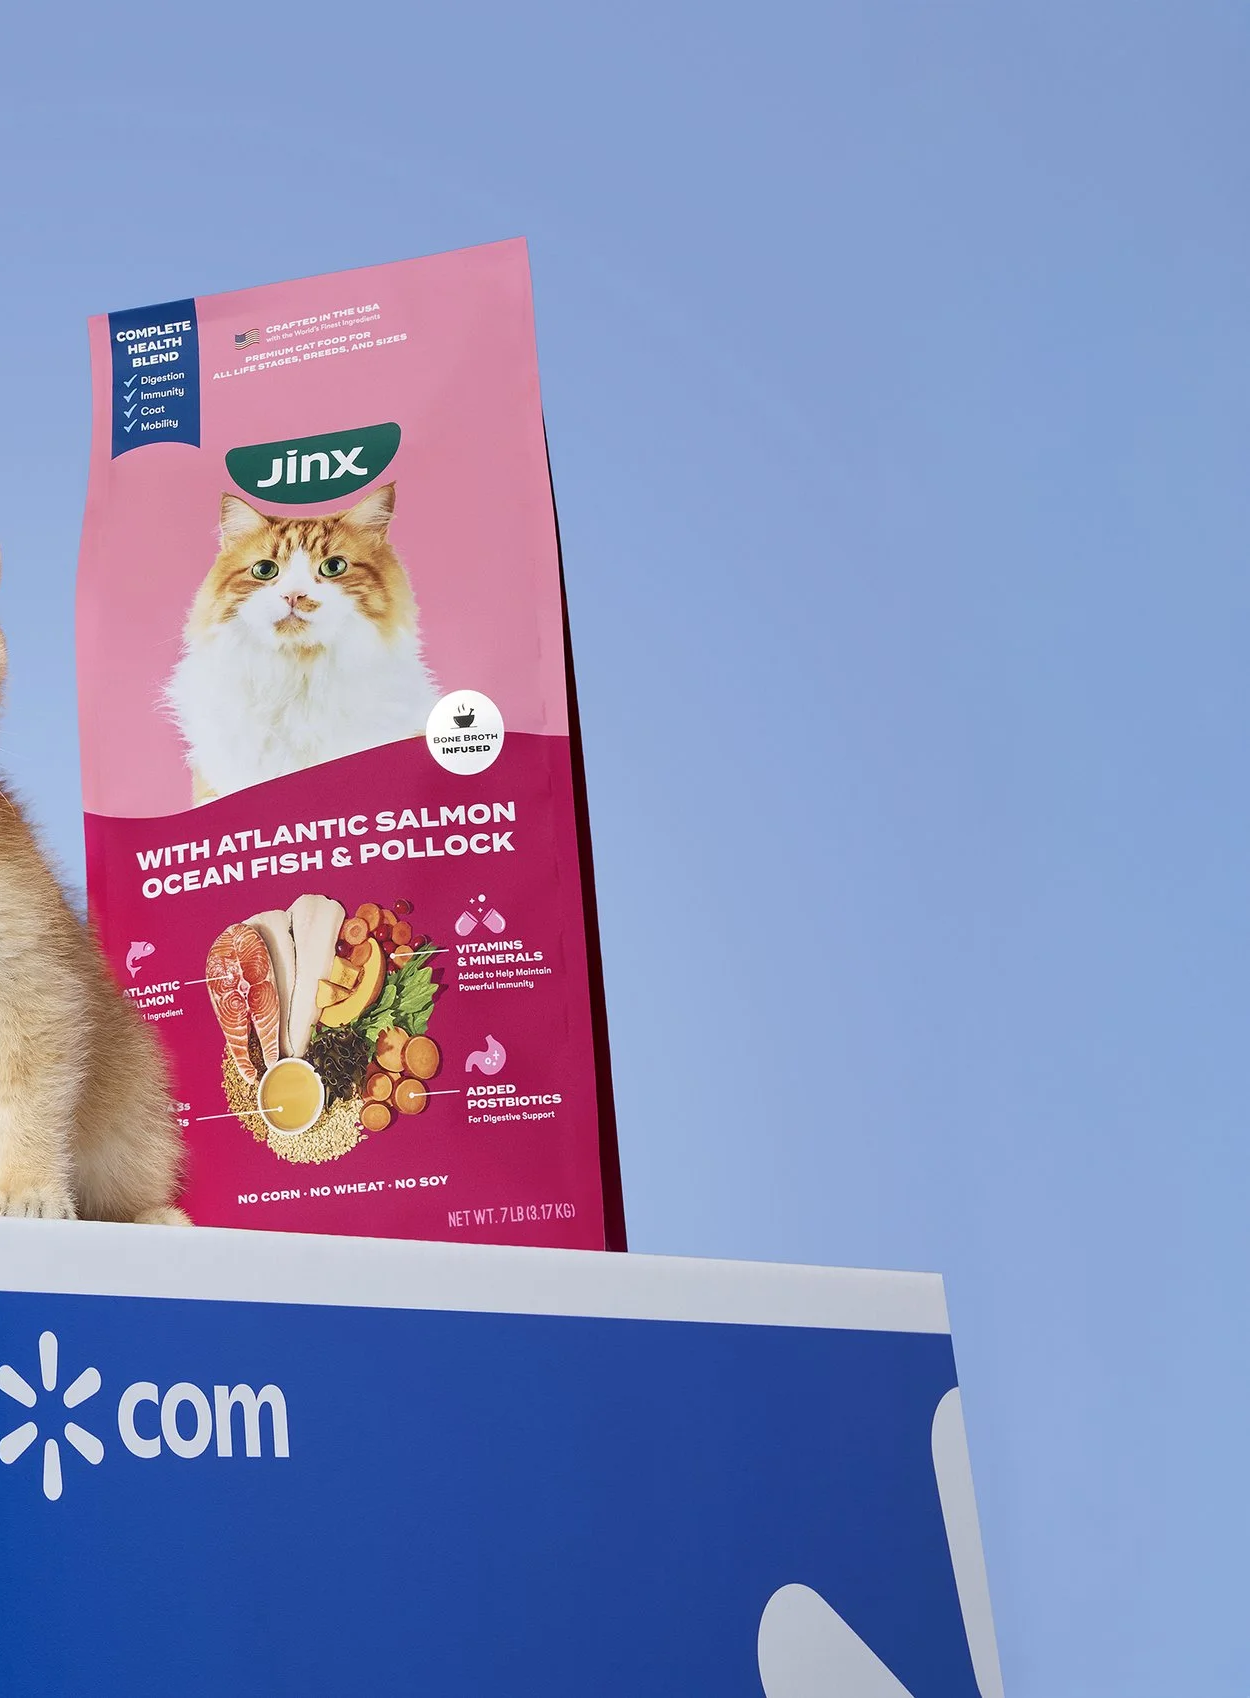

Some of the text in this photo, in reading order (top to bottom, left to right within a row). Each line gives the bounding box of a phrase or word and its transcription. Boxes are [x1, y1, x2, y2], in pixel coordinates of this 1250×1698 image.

[266, 303, 380, 333] CRAFTED IN THE USA
[116, 320, 191, 342] COMPLETE
[266, 335, 281, 343] with
[294, 326, 319, 336] World's
[320, 321, 341, 330] Finest
[342, 314, 380, 326] Ingredients
[127, 336, 182, 355] HEALTH
[245, 331, 371, 363] PREMIUM CAT FOOD FOR
[132, 351, 179, 367] BLEND
[213, 333, 407, 380] ALL LIFE STAGES, BREEDS, AND SIZES
[141, 372, 184, 385] Digestion
[141, 386, 184, 400] Immunity
[141, 405, 165, 416] Coat
[141, 419, 178, 431] Mobility
[442, 745, 491, 754] INFUSED
[136, 800, 517, 872] WITH ATLANTIC SALMON
[141, 831, 516, 900] OCEAN FISH & POLLOCK
[456, 940, 523, 954] VITAMINS
[457, 951, 543, 967] & MINERALS
[458, 967, 551, 981] Added to Help Maintain
[122, 980, 181, 998] ATLANTIC
[459, 980, 534, 992] Powerful Immunity
[147, 1008, 184, 1021] Ingredient
[466, 1084, 516, 1097] ADDED
[467, 1093, 562, 1110] POSTBIOTICS
[468, 1111, 555, 1124] For Digestive Support
[238, 1175, 449, 1204] NO CORN NO WHEAT NO SOY
[448, 1202, 576, 1227] NET WT. 7 LB (3.17 KG)
[117, 1380, 291, 1459] com
